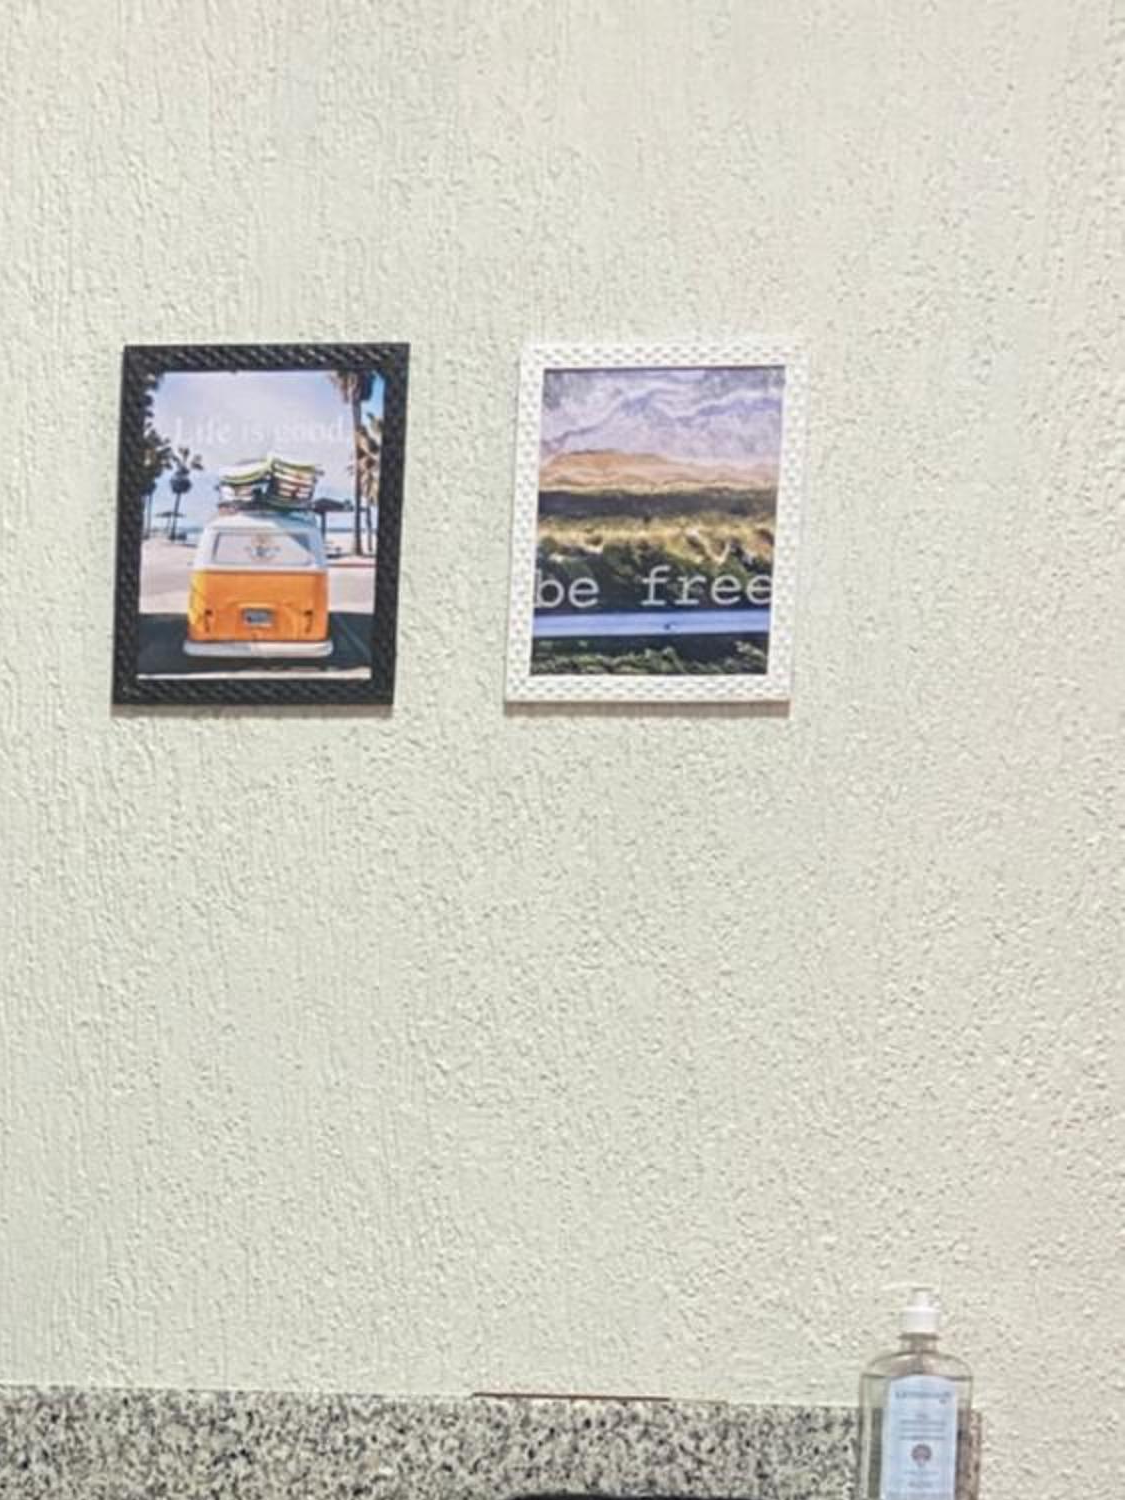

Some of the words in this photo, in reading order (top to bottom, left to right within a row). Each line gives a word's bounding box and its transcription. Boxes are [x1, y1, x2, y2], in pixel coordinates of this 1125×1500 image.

[174, 415, 234, 444] Life
[241, 416, 265, 443] is
[535, 568, 600, 608] be
[641, 565, 772, 607] free
